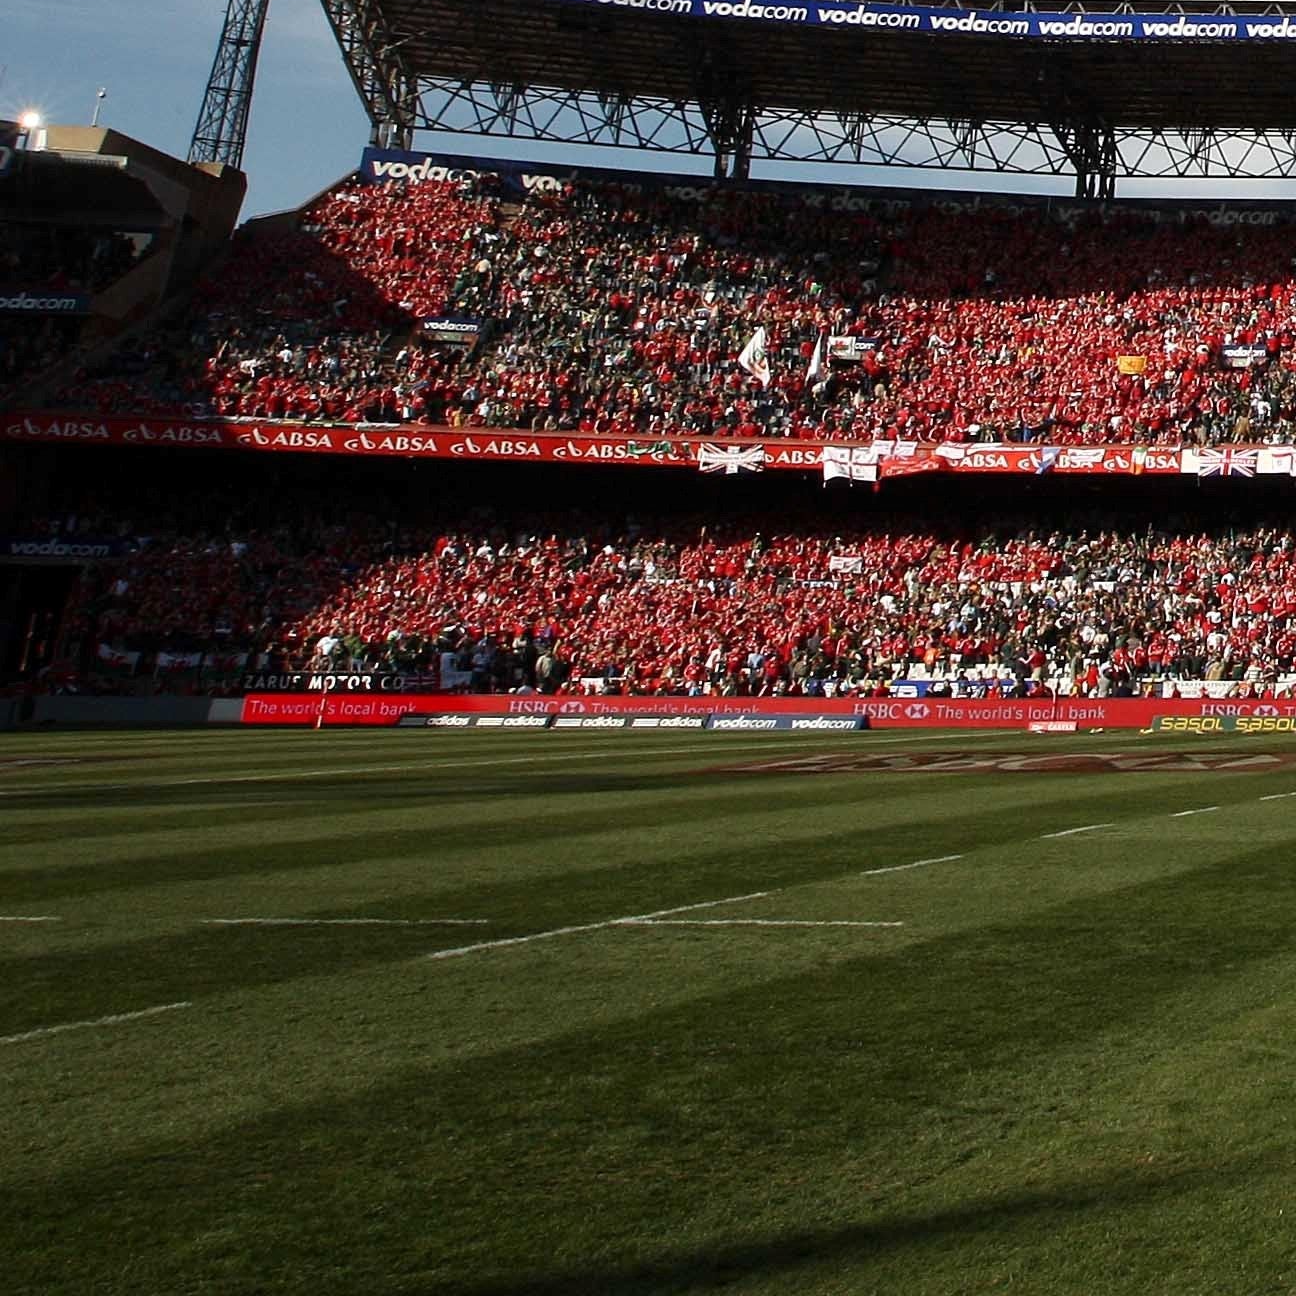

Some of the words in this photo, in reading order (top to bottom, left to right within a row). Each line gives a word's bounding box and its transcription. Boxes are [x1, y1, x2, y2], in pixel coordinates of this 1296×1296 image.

[818, 5, 919, 27] vodacom
[930, 12, 1029, 33] vodacom
[1039, 16, 1132, 35] vodacom
[1143, 17, 1236, 36] vodacom
[46, 422, 109, 439] ABSA
[159, 426, 222, 443] ABSA
[271, 431, 332, 449] ABSA
[377, 436, 437, 452] ABSA
[484, 440, 541, 457] ABSA
[960, 454, 1008, 468] ABSA
[1146, 455, 1180, 469] BSA
[308, 675, 372, 691] MOTOR
[250, 700, 277, 714] The
[340, 700, 375, 715] local
[854, 704, 901, 718] HSBC
[936, 704, 963, 719] The
[968, 704, 1023, 720] world's
[1069, 703, 1104, 719] bank
[427, 714, 469, 726] adidas
[503, 714, 547, 727] adidas
[582, 714, 625, 727] adidas
[660, 714, 702, 727] adidas
[712, 716, 777, 729] vodacom
[791, 716, 856, 729] vodacom
